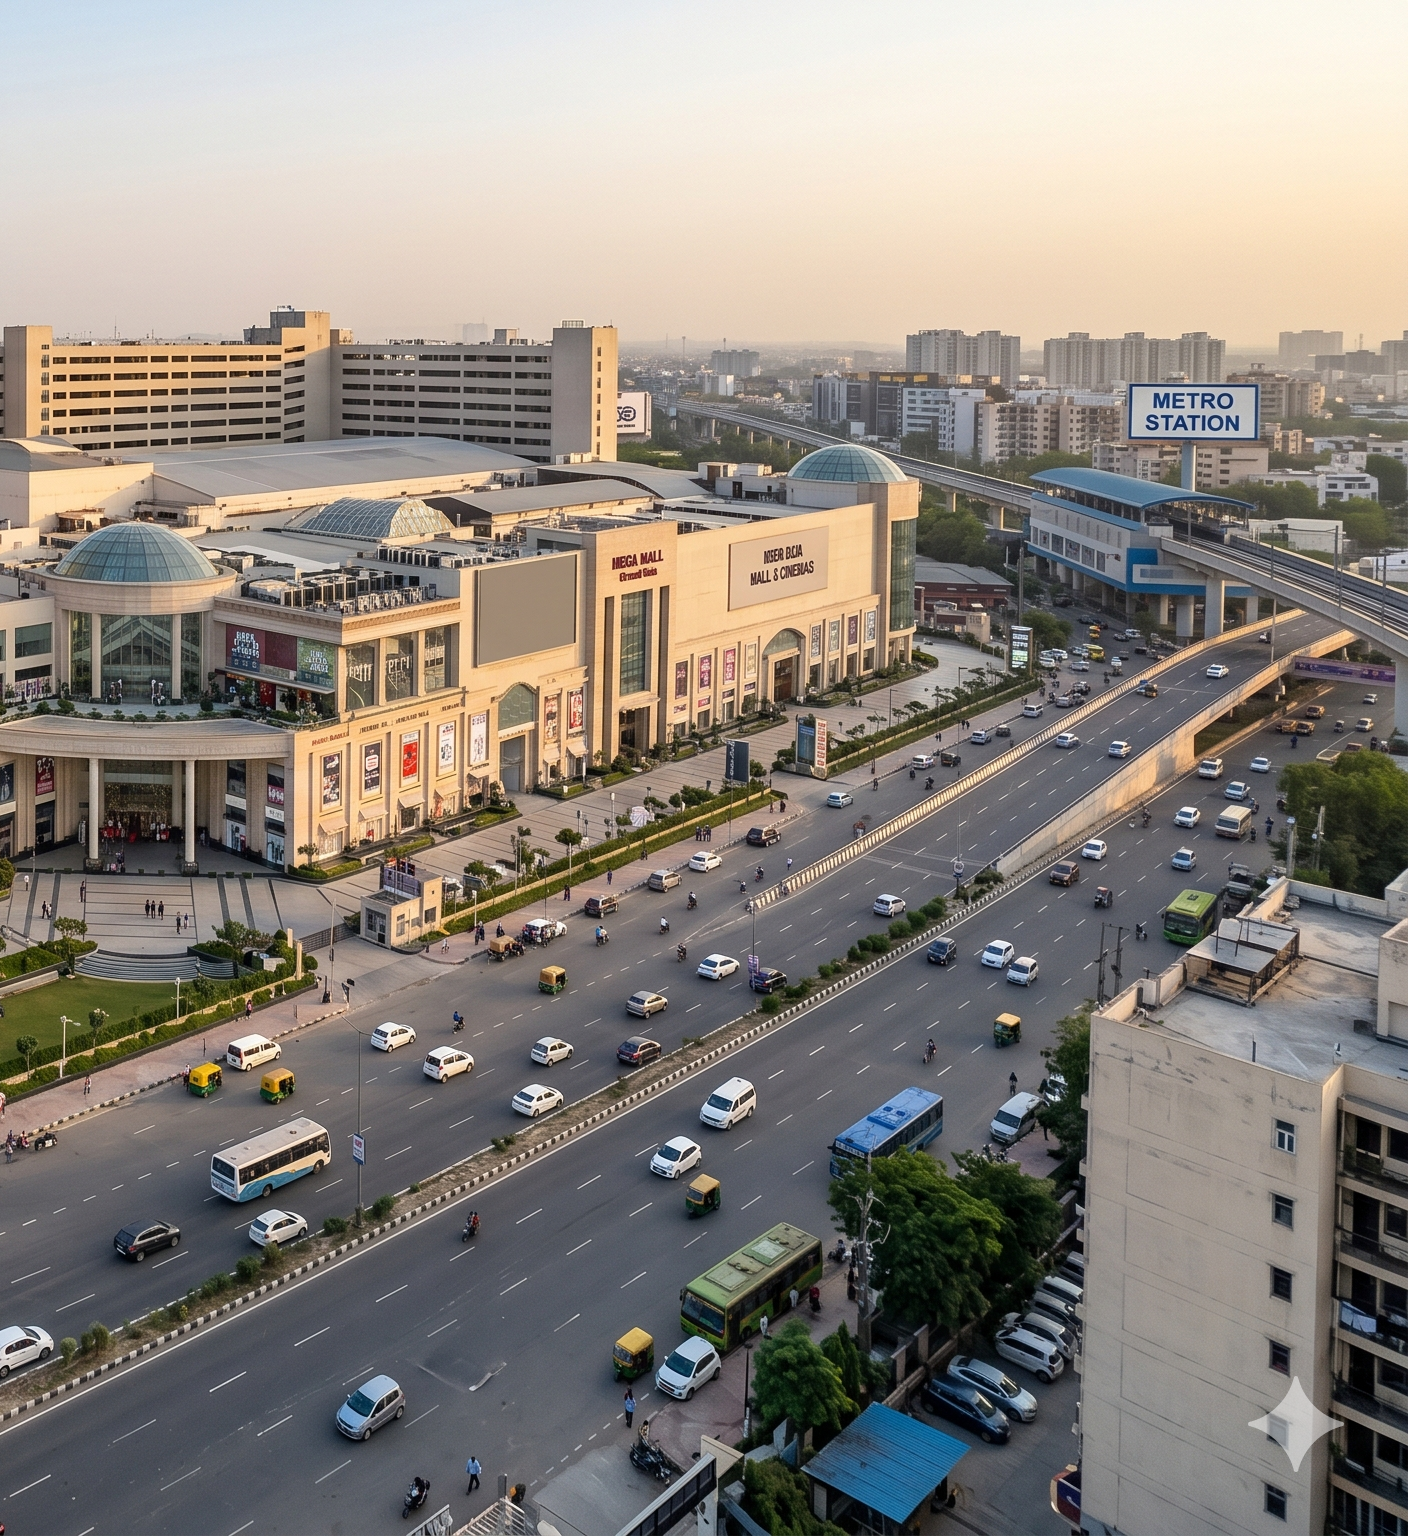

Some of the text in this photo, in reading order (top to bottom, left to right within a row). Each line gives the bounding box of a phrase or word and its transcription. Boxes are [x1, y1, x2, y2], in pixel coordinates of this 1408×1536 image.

[1153, 392, 1234, 410] METRO
[1145, 414, 1240, 431] STATION
[612, 549, 664, 570] MEGA MALL
[750, 569, 771, 586] MALL
